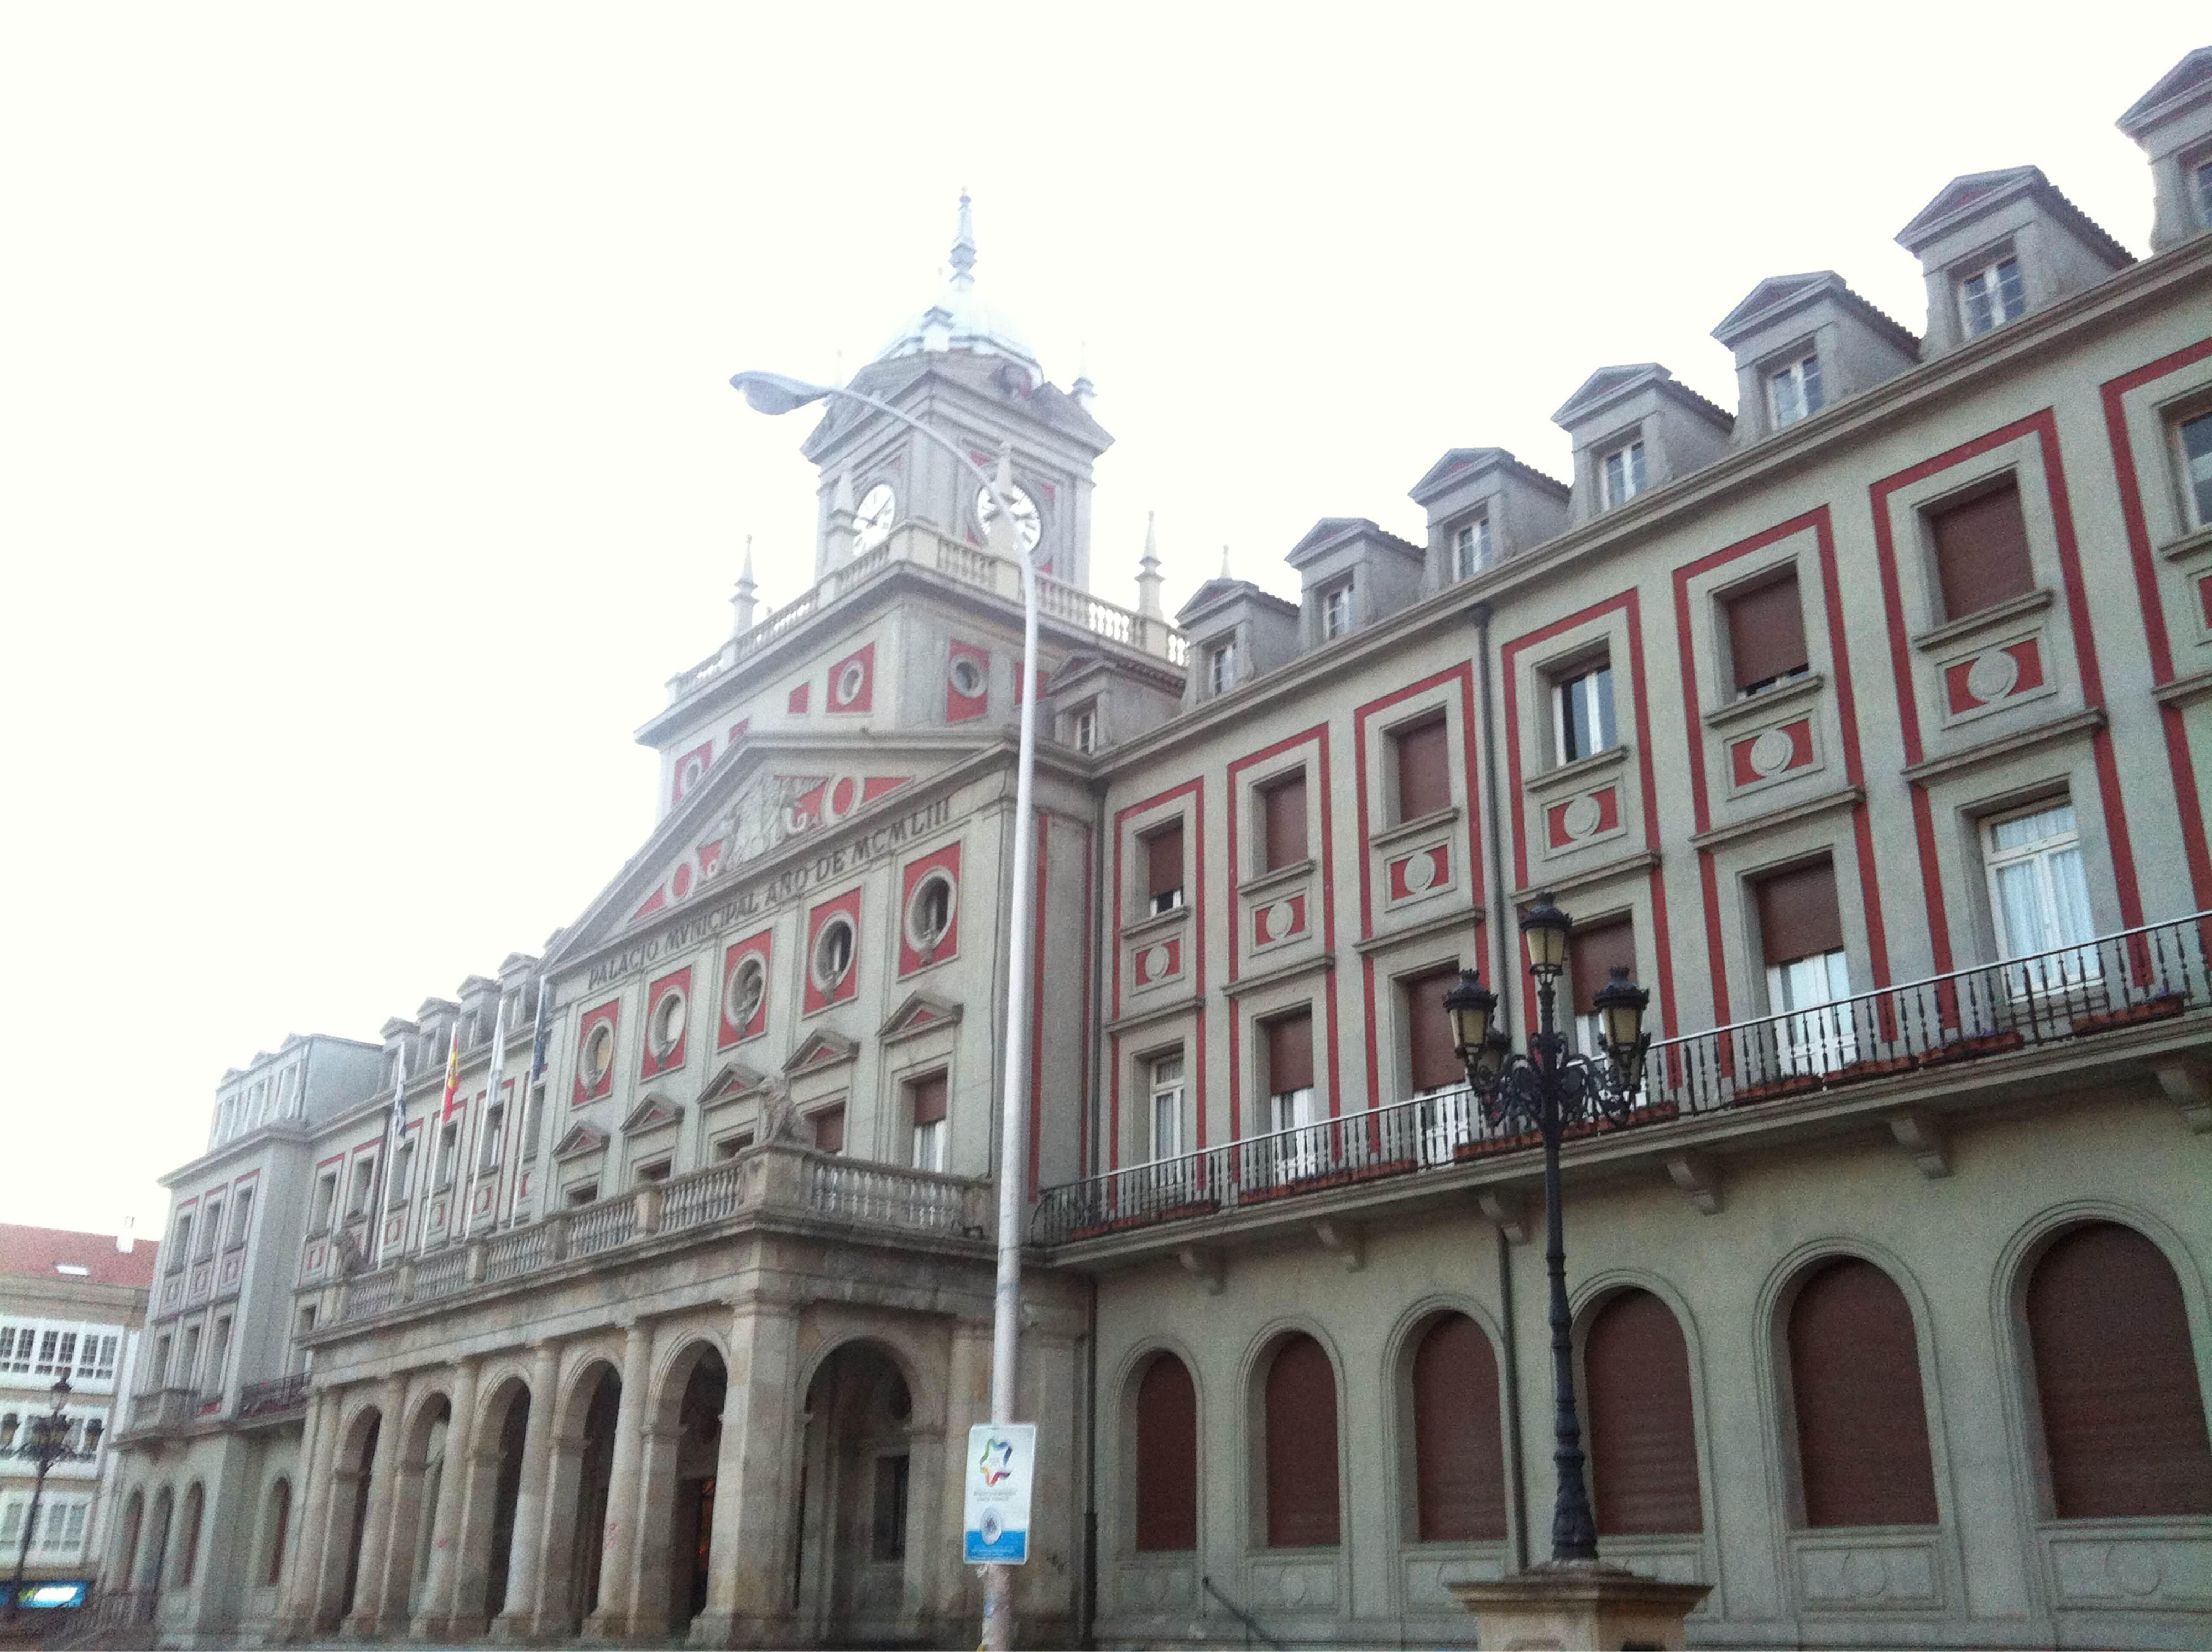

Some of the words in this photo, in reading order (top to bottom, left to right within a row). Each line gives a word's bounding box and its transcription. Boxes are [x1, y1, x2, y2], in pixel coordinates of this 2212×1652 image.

[588, 941, 659, 990] PALACIO
[816, 848, 846, 881] DE
[850, 797, 950, 862] MCMLIII
